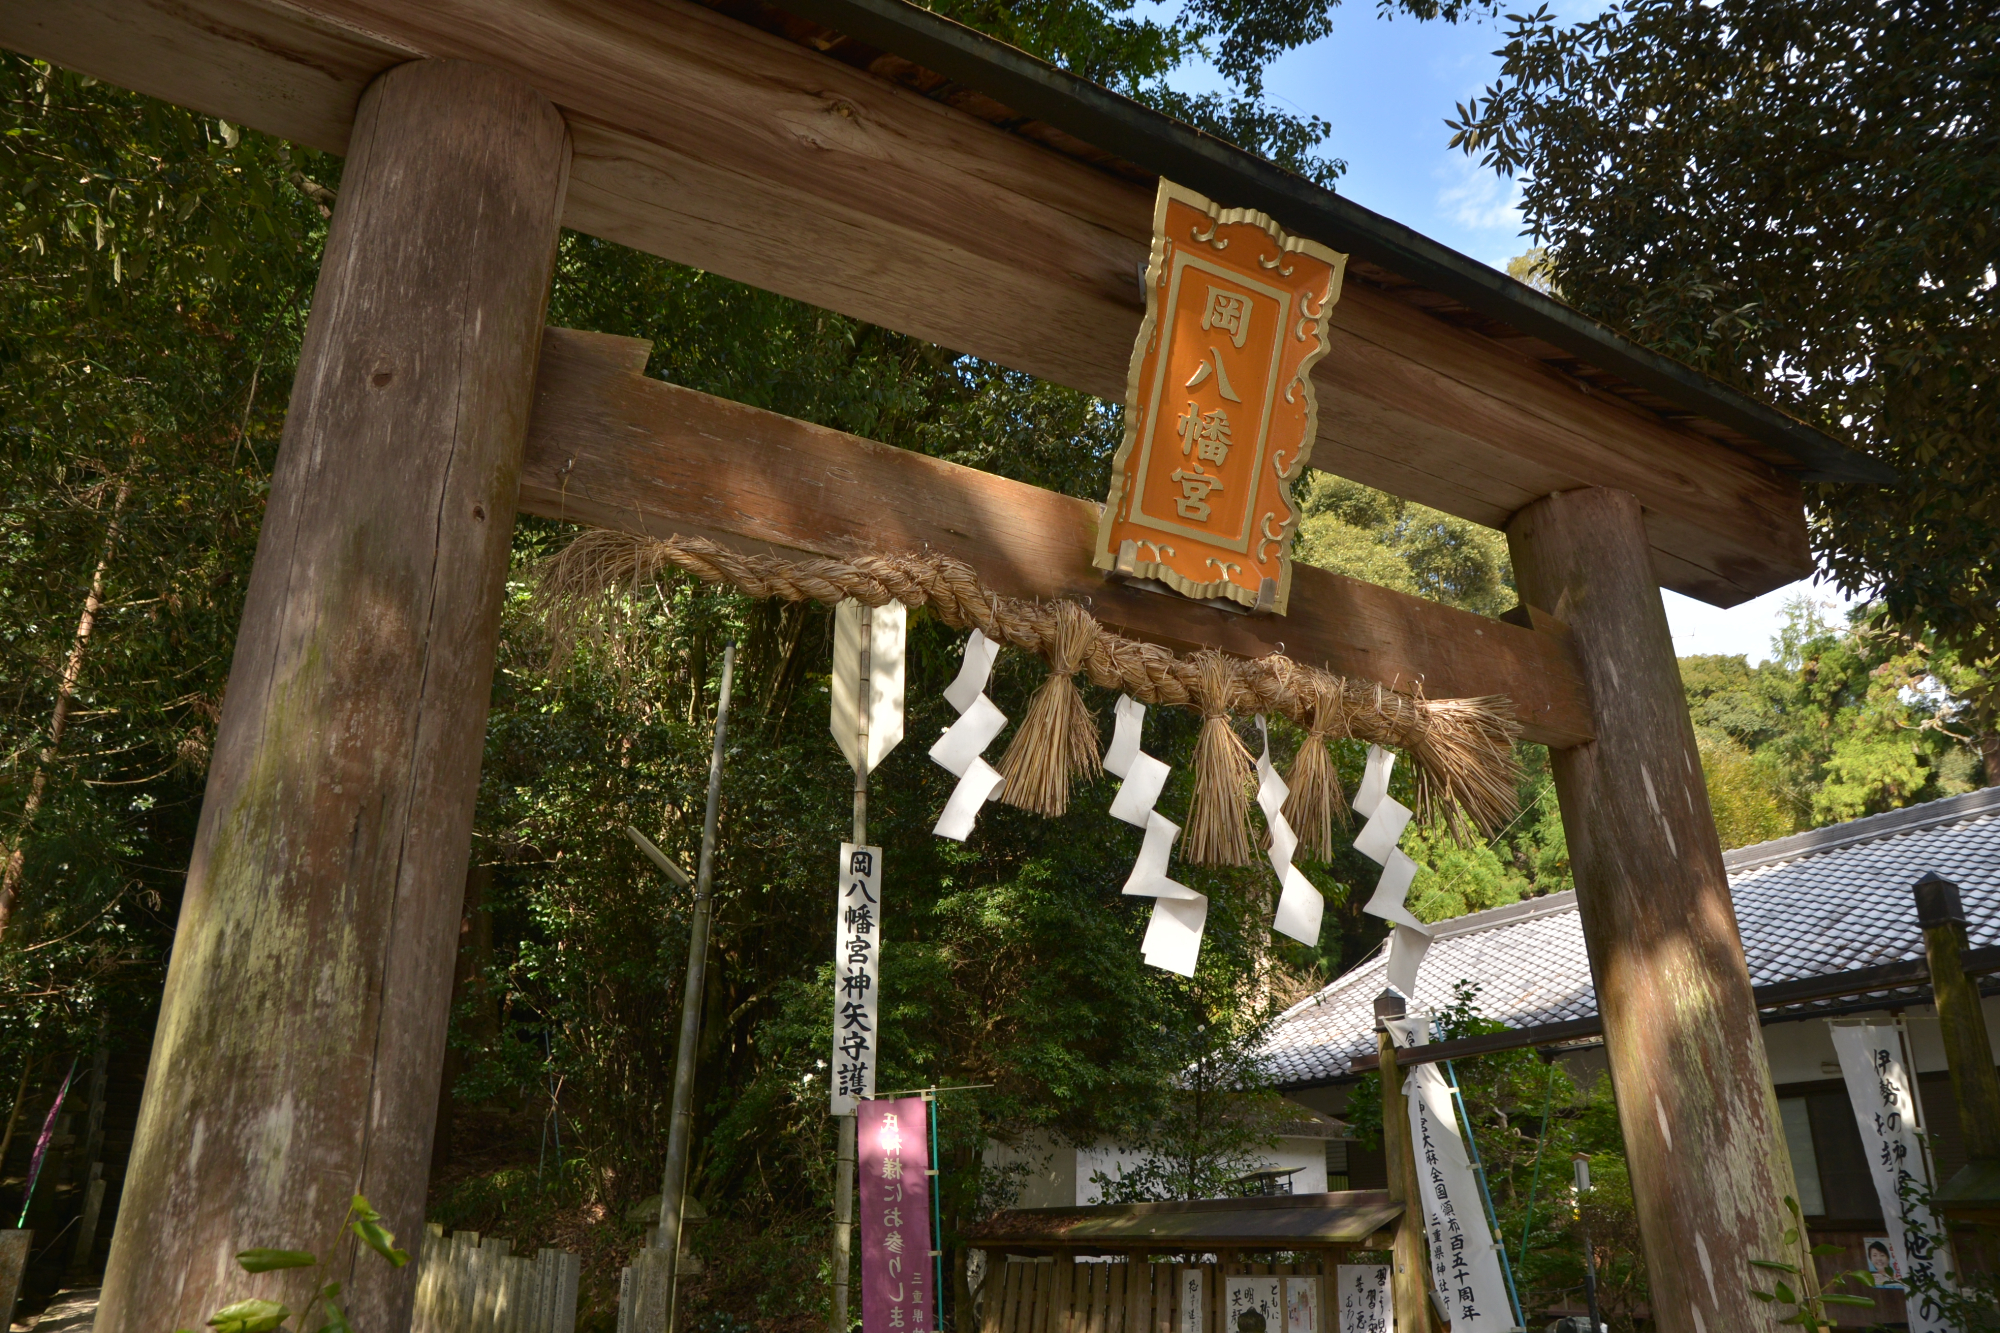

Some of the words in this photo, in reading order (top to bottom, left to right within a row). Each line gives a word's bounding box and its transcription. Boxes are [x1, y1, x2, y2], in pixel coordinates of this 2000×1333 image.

[1170, 284, 1254, 523] 岡八幡宮
[837, 850, 878, 1101] 岡八幡宮神矢守護
